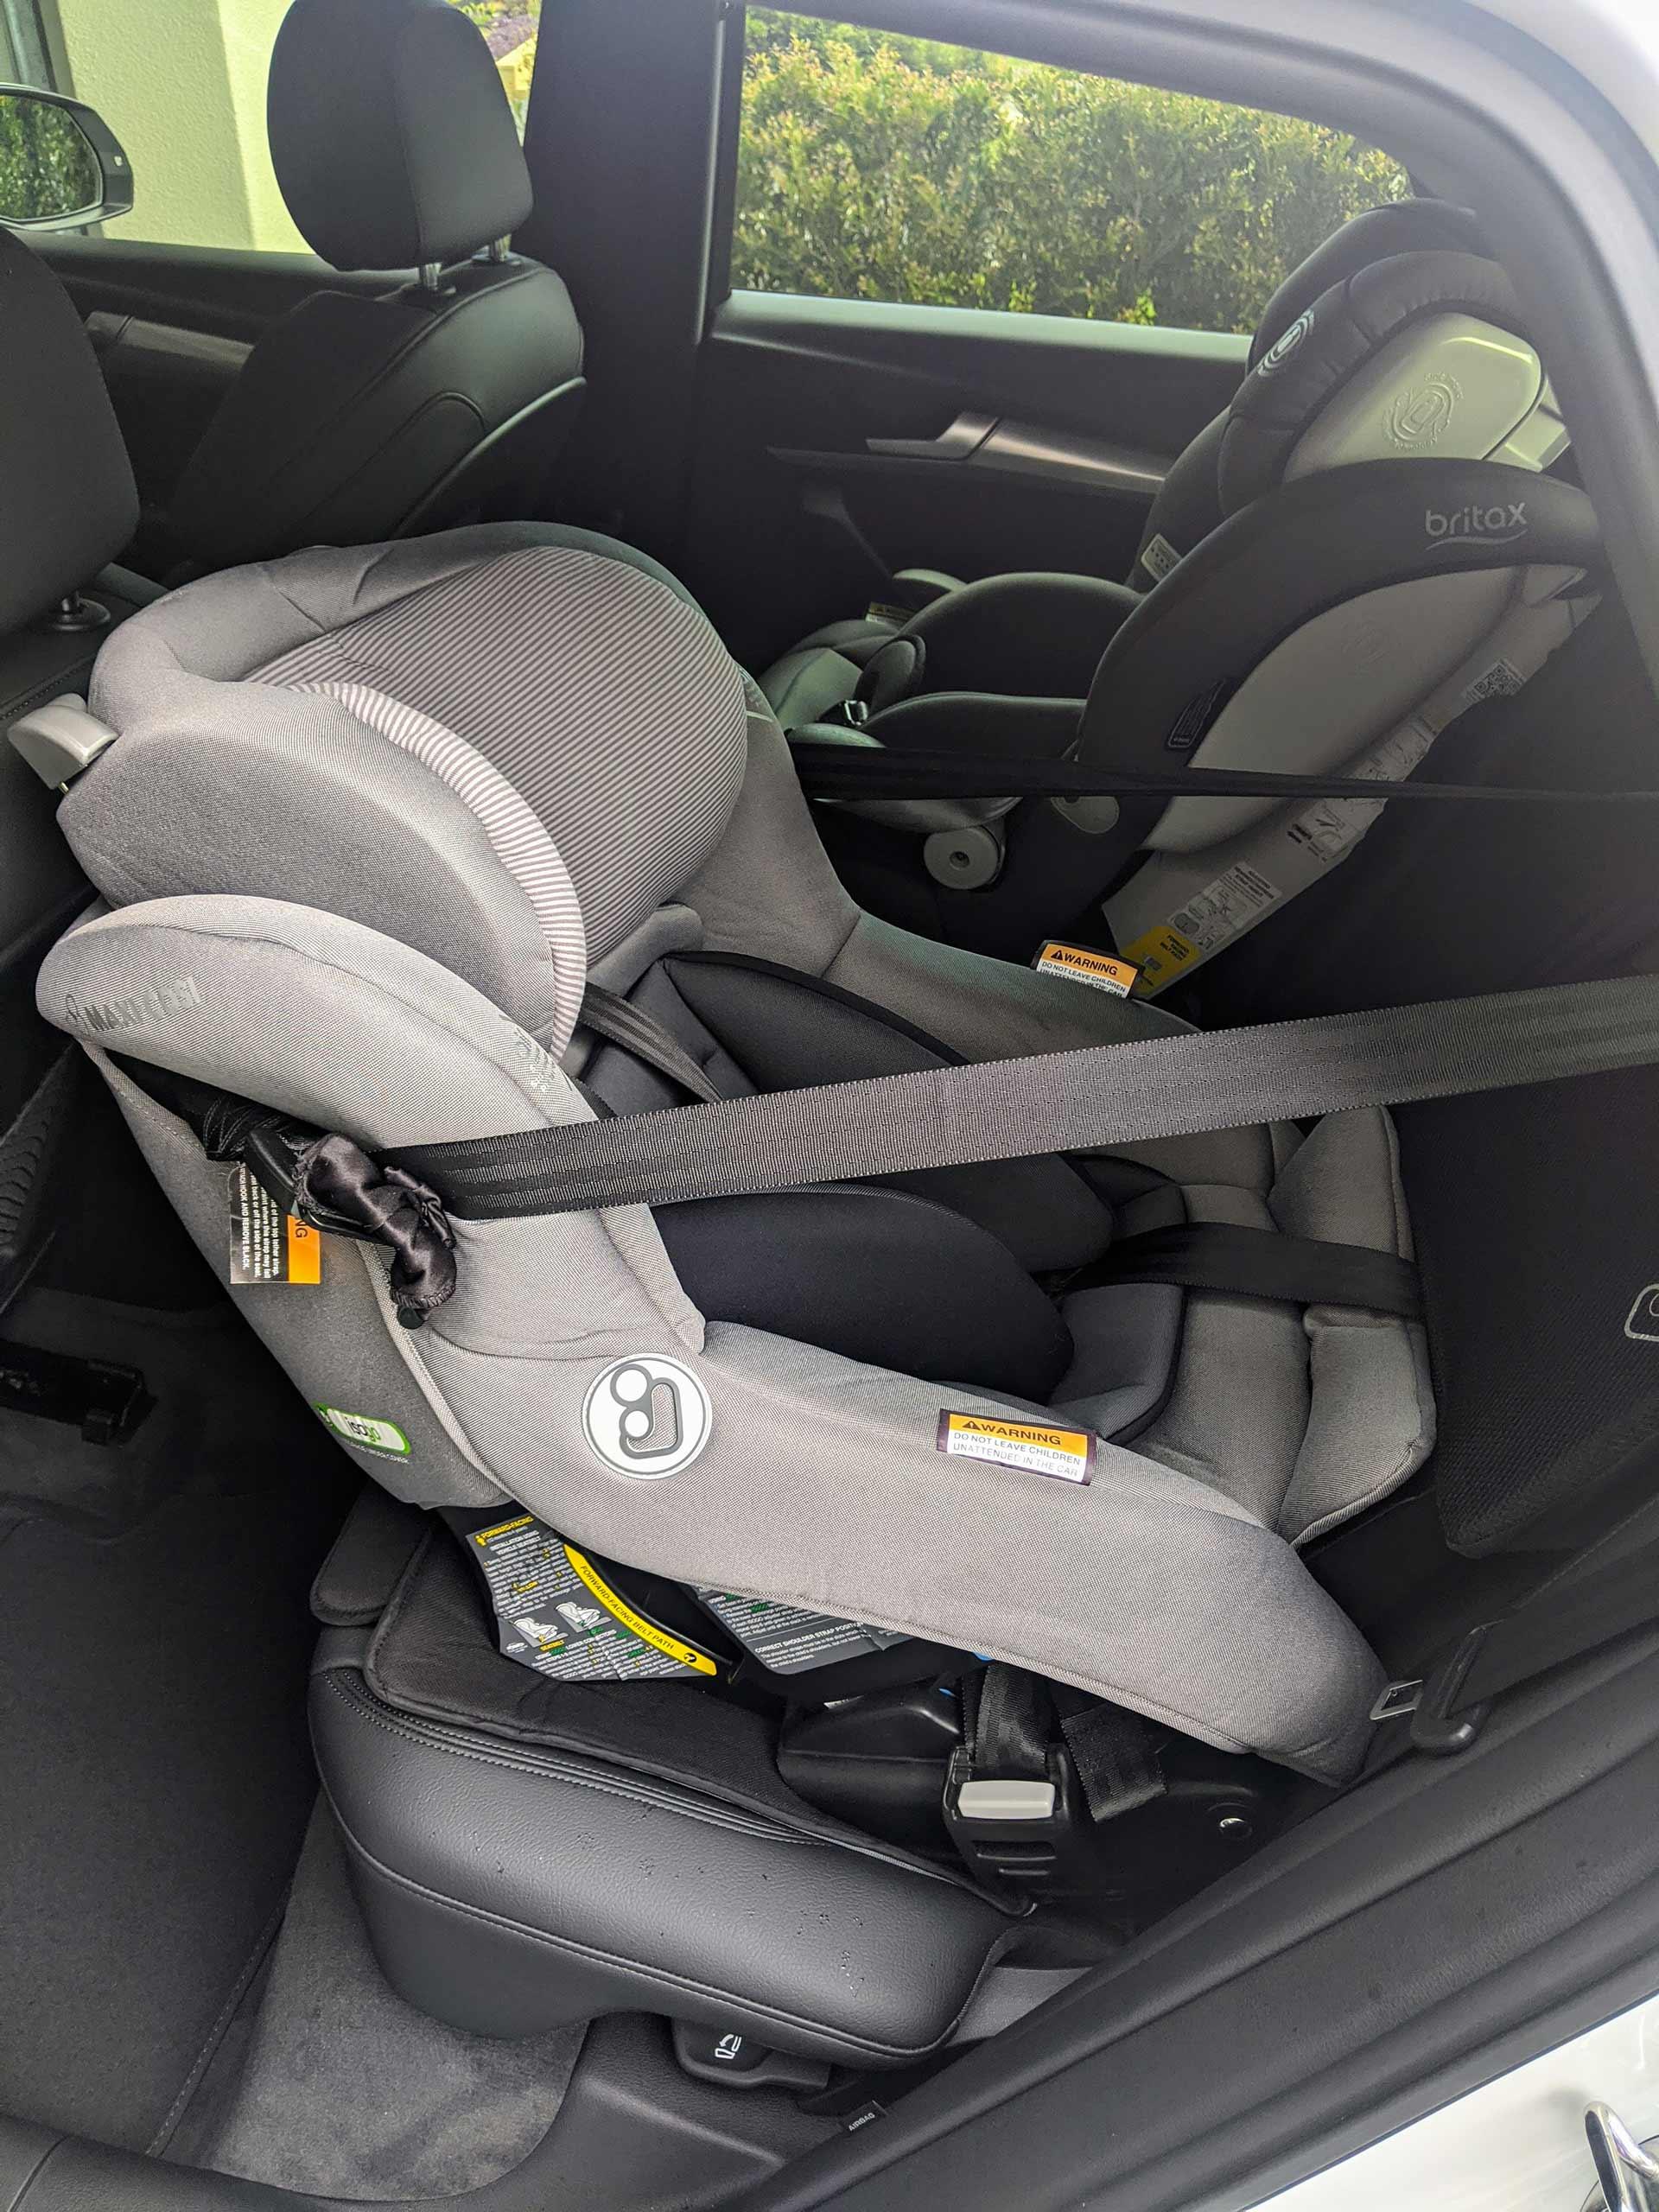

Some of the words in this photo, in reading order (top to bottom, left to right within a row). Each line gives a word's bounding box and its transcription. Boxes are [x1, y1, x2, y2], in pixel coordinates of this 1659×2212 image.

[1426, 502, 1527, 537] britax
[1053, 964, 1068, 973] NOT
[1068, 969, 1090, 980] LEAVE
[1091, 976, 1126, 993] CHILDREN
[1064, 952, 1118, 976] WARNING
[239, 1185, 248, 1201] HOOK
[954, 1432, 969, 1440] DO
[971, 1434, 992, 1445] NOT
[995, 1440, 1027, 1452] LEAVE
[1029, 1446, 1080, 1465] CHILDREN
[982, 1423, 1061, 1446] WARNING
[953, 1443, 1021, 1462] UNATTENDED
[1037, 1459, 1054, 1471] THE
[1057, 1465, 1078, 1477] CAR
[580, 1565, 634, 1623] FORWARD-FACING
[633, 1621, 652, 1637] BELT
[652, 1633, 675, 1650] PATH
[848, 2112, 875, 2131] AIRBAG
